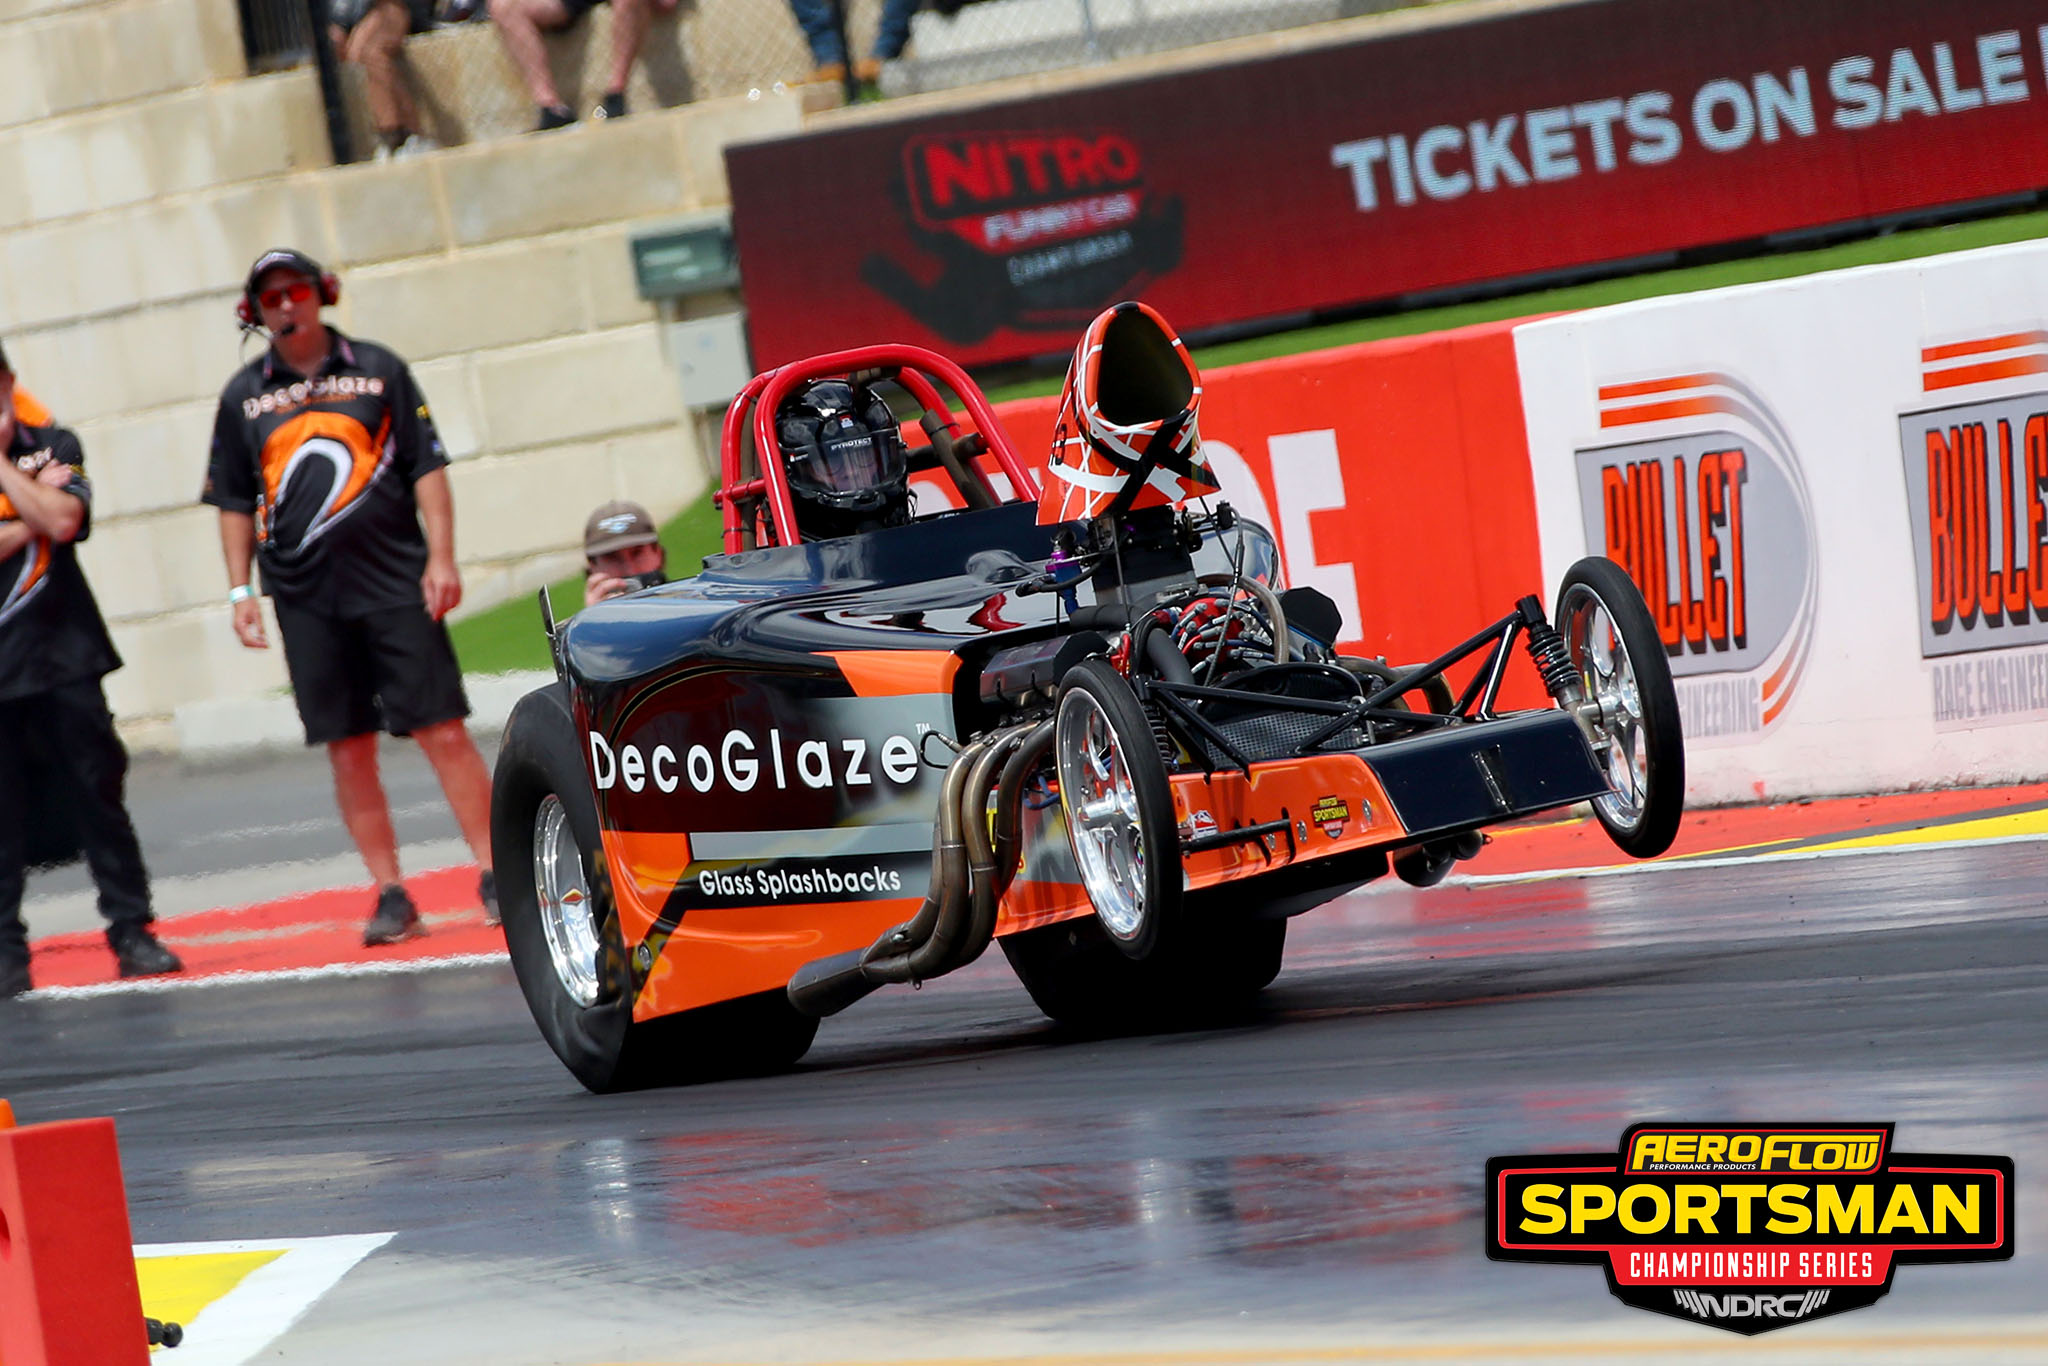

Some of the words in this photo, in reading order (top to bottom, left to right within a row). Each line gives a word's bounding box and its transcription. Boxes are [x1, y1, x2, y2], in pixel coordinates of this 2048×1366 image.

[1332, 90, 1683, 210] TICKETS
[1691, 67, 1817, 153] ON
[1829, 30, 2029, 131] SALE
[925, 134, 1143, 206] NITRO
[831, 437, 872, 450] PYROTECT
[1926, 412, 2048, 636] BULLE
[1677, 677, 1760, 739] GINEERING
[1933, 660, 1975, 722] RACE
[1978, 653, 2048, 717] ENGINEE
[589, 729, 918, 793] DecoGlaze
[699, 870, 754, 896] Glass
[758, 866, 901, 900] Splashbacks
